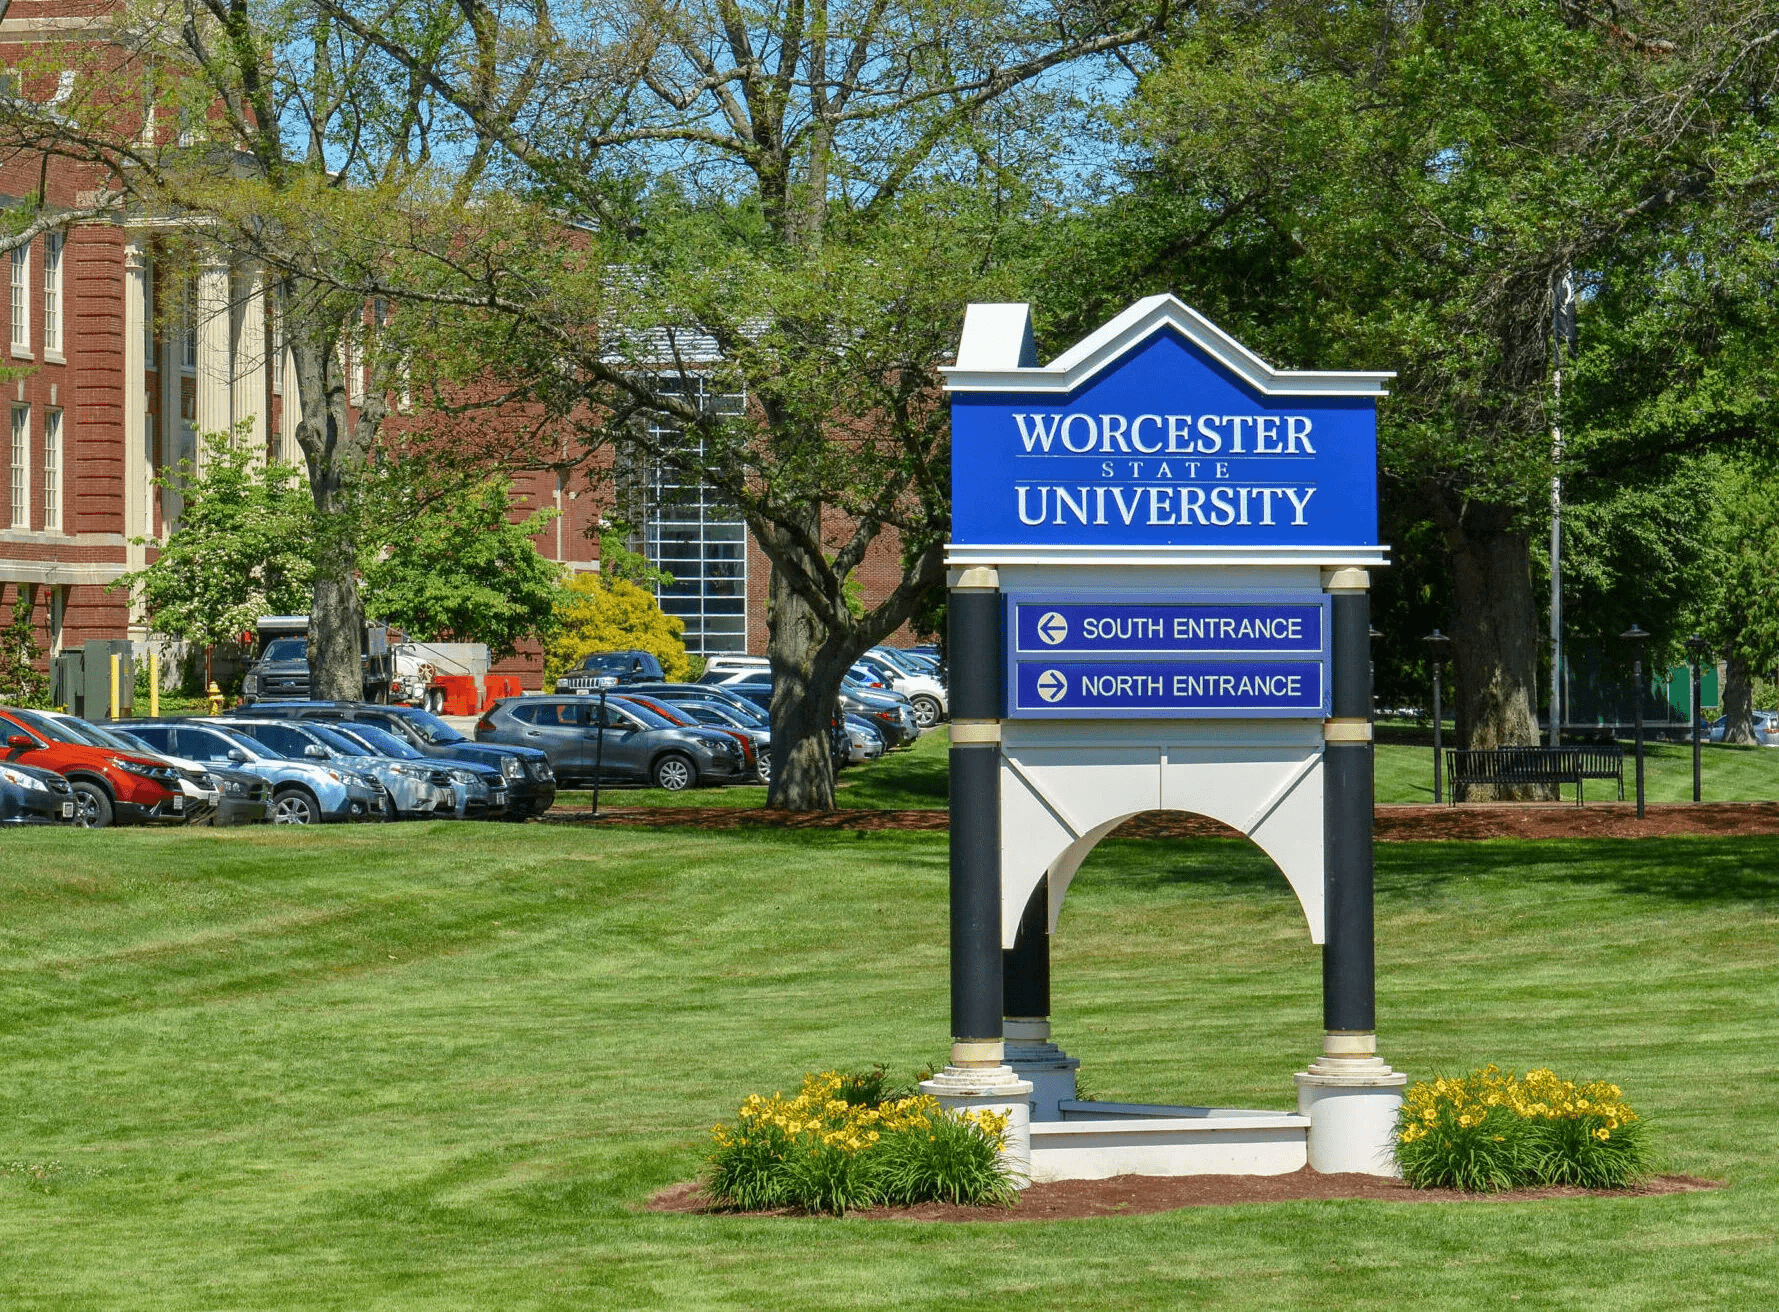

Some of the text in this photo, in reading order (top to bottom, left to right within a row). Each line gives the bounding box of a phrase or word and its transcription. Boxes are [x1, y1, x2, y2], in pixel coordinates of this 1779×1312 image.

[1013, 413, 1317, 454] WORCESTER
[1101, 461, 1230, 479] STATE
[1014, 486, 1317, 526] UNIVERSITY
[1083, 617, 1303, 639] SOUTH ENTRANCE
[1081, 675, 1303, 697] NORTH ENTRANCE
